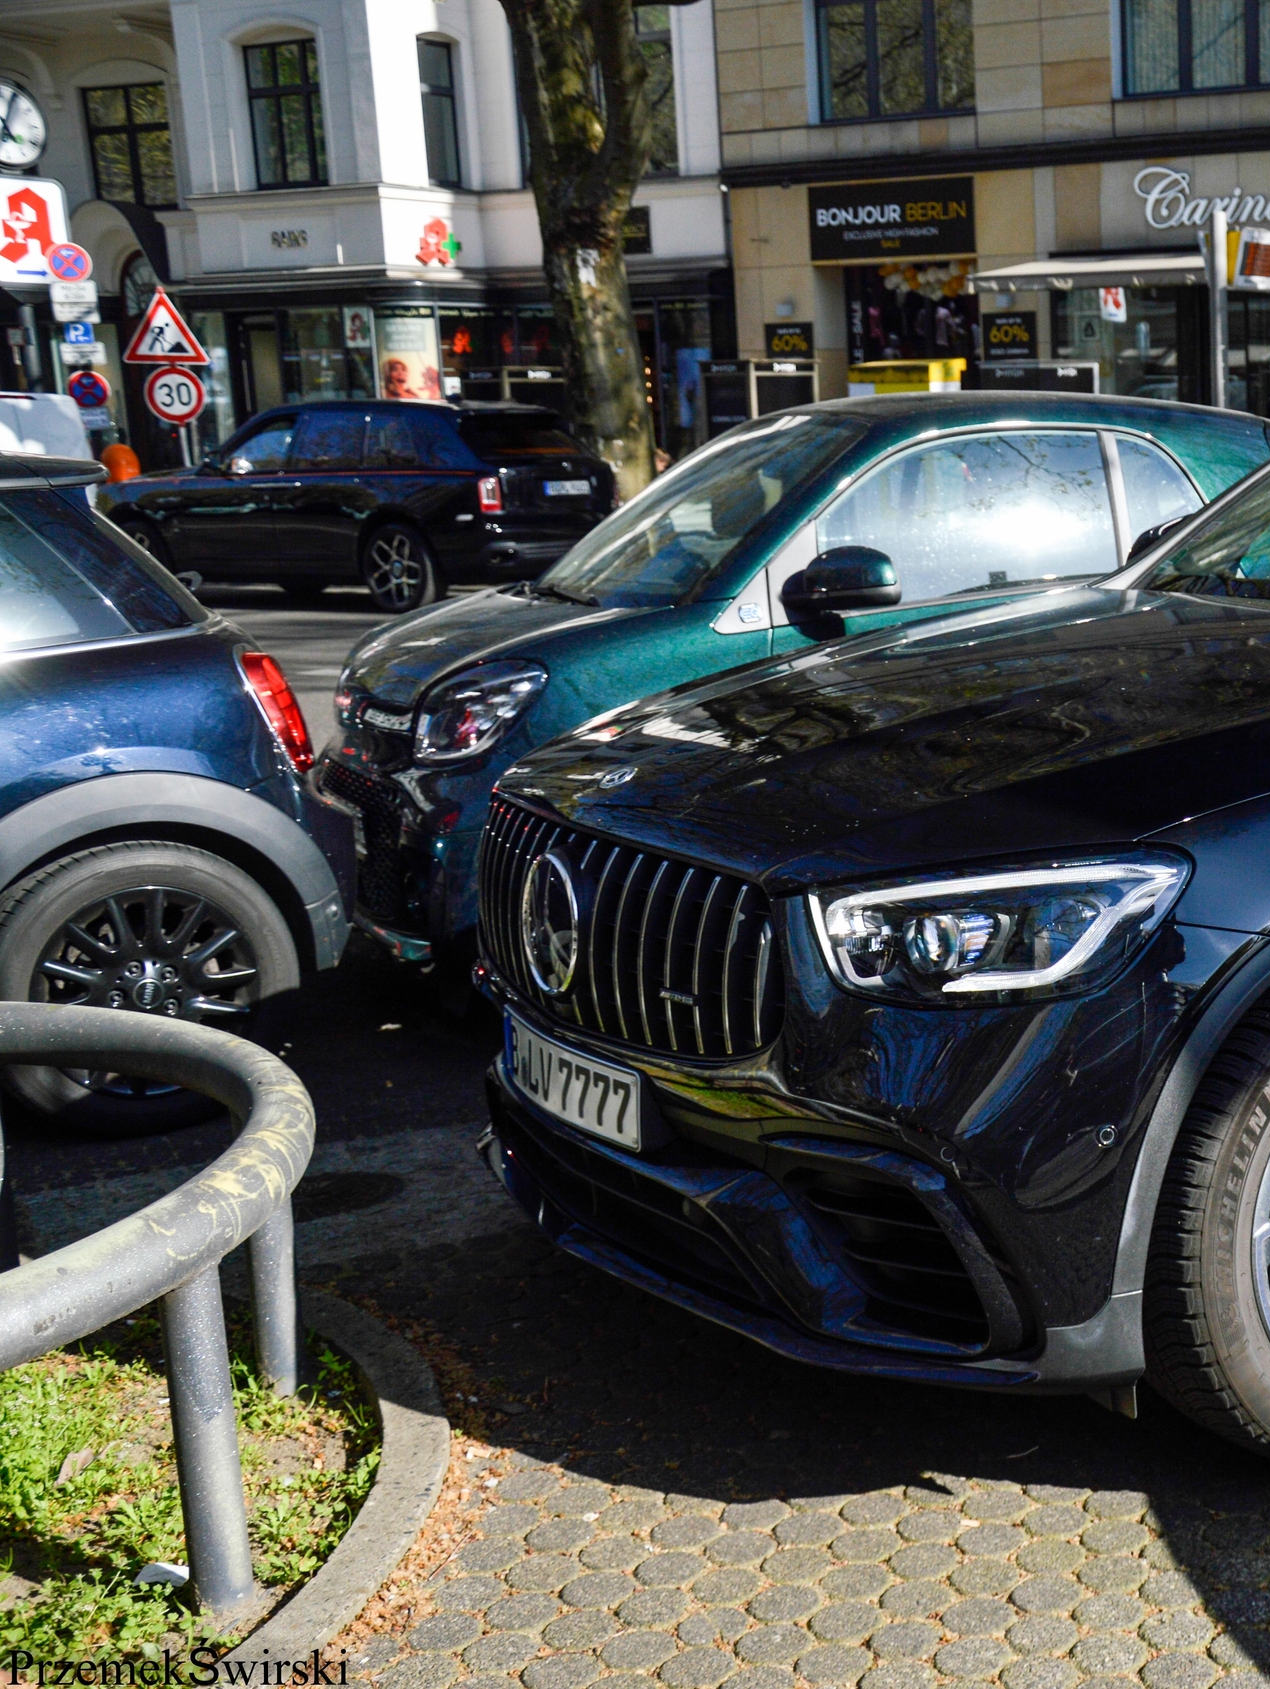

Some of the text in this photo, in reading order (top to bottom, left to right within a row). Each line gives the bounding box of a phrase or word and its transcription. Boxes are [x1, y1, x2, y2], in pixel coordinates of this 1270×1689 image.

[816, 201, 968, 228] BONJOUR BERLIN
[69, 323, 85, 342] P
[771, 334, 809, 353] 60%
[988, 324, 1030, 344] 60%
[158, 382, 193, 408] 30
[558, 1057, 632, 1135] 7777
[1215, 1104, 1269, 1297] MICHELIN
